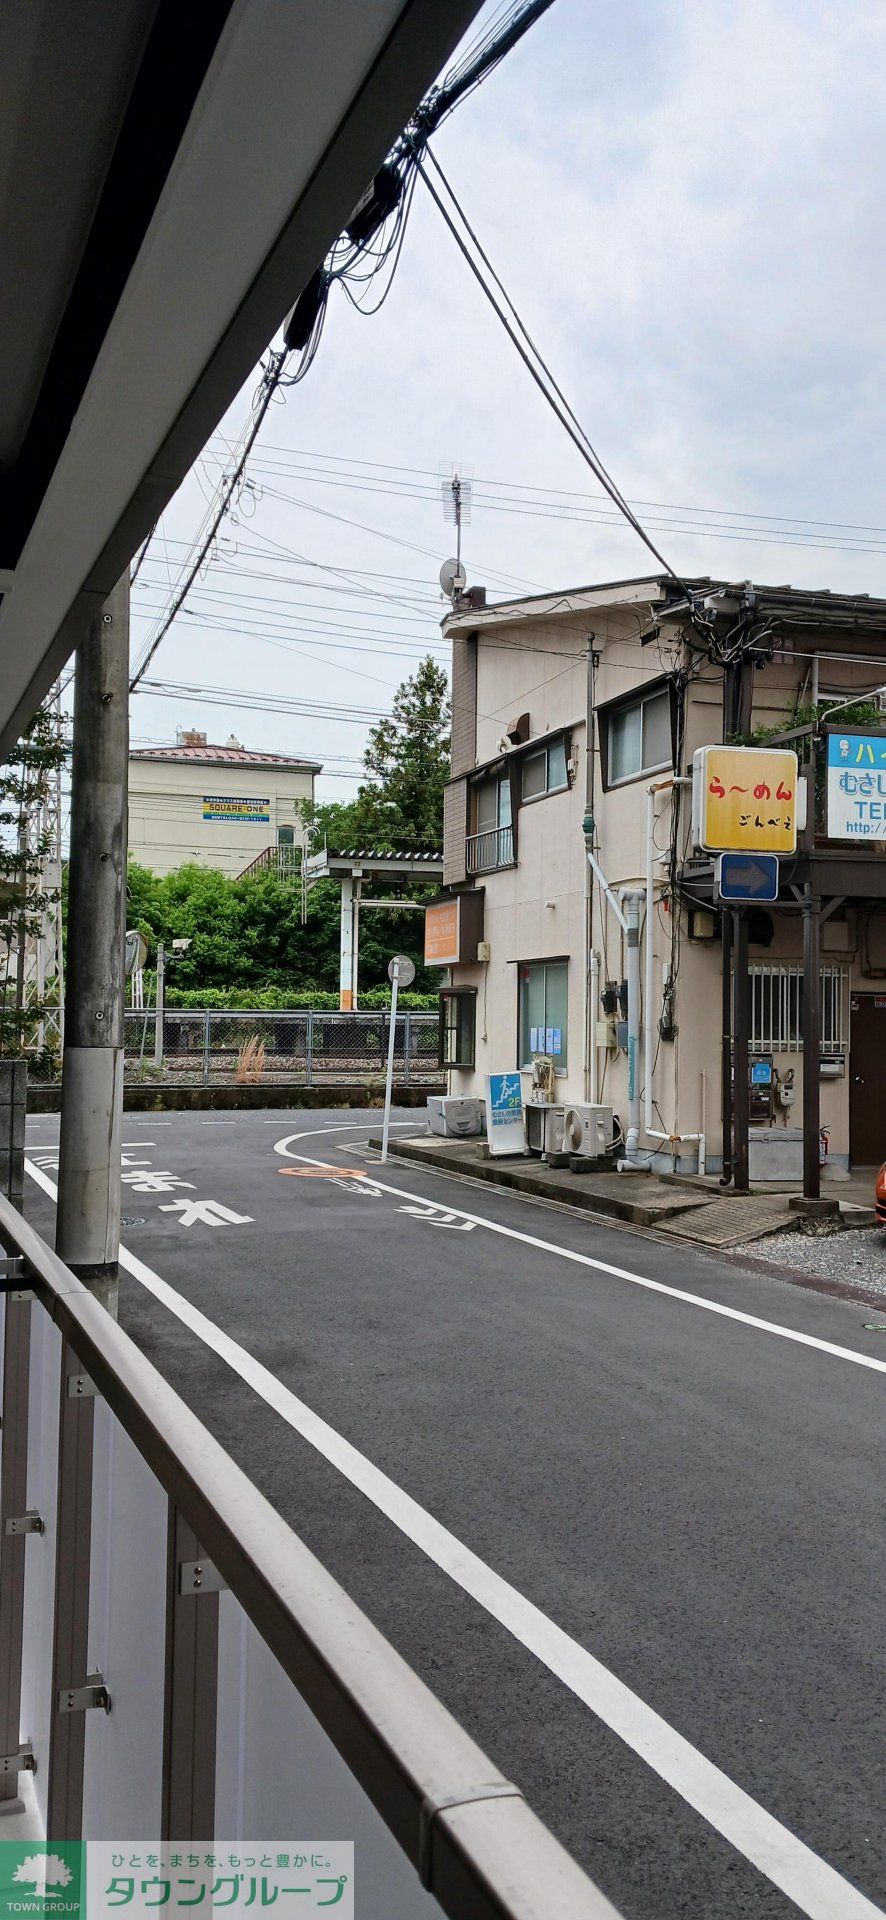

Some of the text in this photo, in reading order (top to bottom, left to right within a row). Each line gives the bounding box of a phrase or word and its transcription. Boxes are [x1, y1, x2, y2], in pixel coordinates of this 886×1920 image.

[854, 802, 886, 820] TE
[739, 815, 792, 830] ごんべえ
[508, 1096, 521, 1108] 2F
